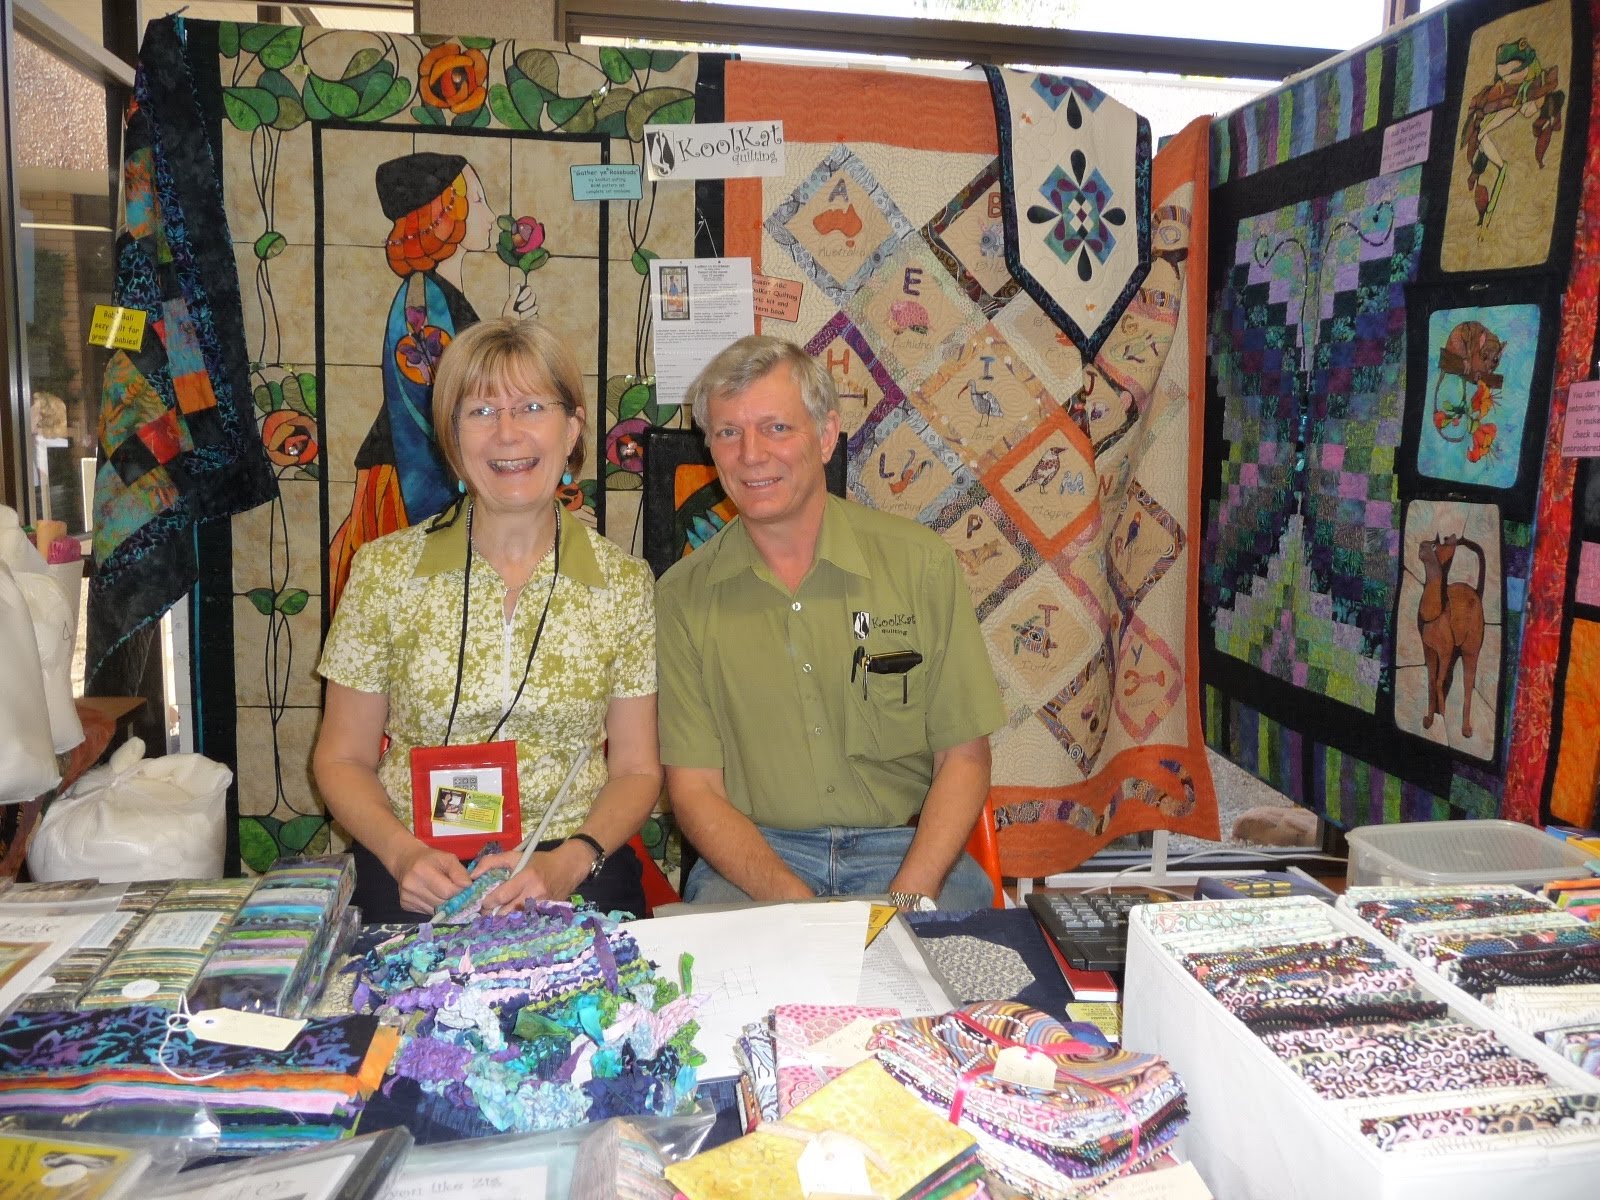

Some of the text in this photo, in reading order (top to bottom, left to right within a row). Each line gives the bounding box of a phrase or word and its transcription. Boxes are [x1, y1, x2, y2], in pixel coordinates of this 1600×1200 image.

[677, 124, 782, 162] KoolKat
[731, 150, 778, 166] quilting
[828, 178, 849, 203] A
[902, 267, 924, 296] E
[773, 290, 798, 302] Quilting
[121, 312, 135, 321] Bali
[770, 307, 785, 316] book
[827, 348, 850, 377] H
[980, 356, 996, 380] I
[879, 452, 895, 478] L
[1059, 470, 1085, 496] M
[967, 513, 984, 539] P
[872, 614, 916, 628] KoolKat
[1038, 604, 1059, 628] T
